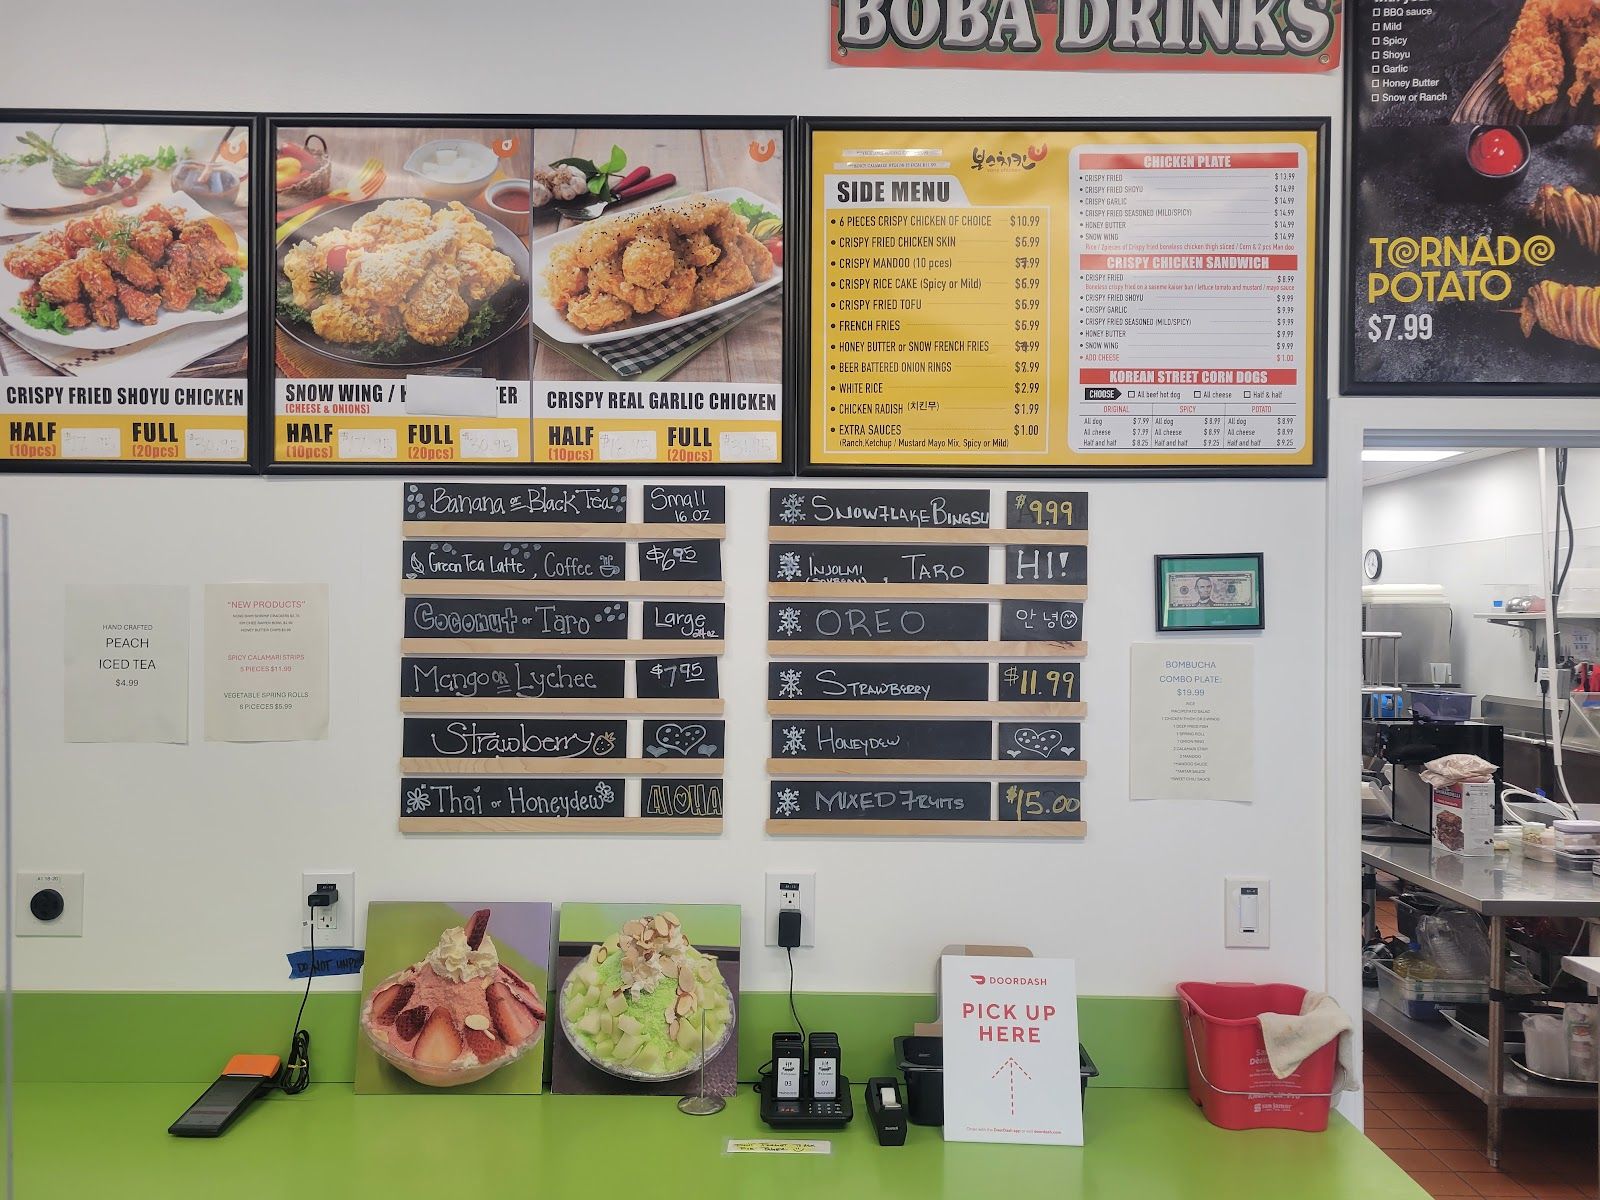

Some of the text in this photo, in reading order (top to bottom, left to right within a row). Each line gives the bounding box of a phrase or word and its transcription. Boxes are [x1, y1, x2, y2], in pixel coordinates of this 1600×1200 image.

[1384, 8, 1403, 16] BBQ
[840, 0, 1331, 52] BOBA DRINKS
[1383, 22, 1402, 31] Mild
[1383, 36, 1407, 46] Spicy
[1383, 51, 1410, 60] Shoyu
[1383, 65, 1408, 73] Garlic
[1383, 78, 1439, 89] Honey Butter
[1382, 94, 1406, 102] Snow
[1419, 93, 1447, 101] Ranch
[1144, 156, 1231, 168] CHICKEN PLATE
[838, 181, 950, 202] SIDE MENU
[840, 216, 1039, 226] 6 PIECES CRISPY CHICKEN OF CHOICE $10.99
[839, 237, 956, 248] CRISPY FRIED CHICKEN SKIN
[1369, 235, 1555, 268] TORNADO
[840, 258, 868, 269] CRISPY
[873, 258, 909, 268] MANDOO
[913, 258, 926, 268] (10
[929, 258, 951, 269] pces)
[1107, 257, 1269, 269] CRISPY CHICKEN SANDWICH
[1368, 270, 1512, 303] POTATO
[1368, 313, 1433, 342] $7.99
[1109, 371, 1267, 383] KOREAN STREET CORN DOGS
[7, 387, 244, 406] CRISPY FRIED SHOYU CHICKEN
[286, 384, 334, 403] SNOW
[339, 385, 385, 403] WING
[839, 383, 1039, 393] WHITE RICE $2.99
[1089, 390, 1115, 398] CHOOSE
[285, 403, 370, 415] (CHEESE & ONIONS)
[547, 391, 776, 411] CRISPY REAL GARLIC CHICKEN
[839, 404, 872, 414] CHICKEN
[875, 404, 903, 414] RADISH
[1015, 403, 1039, 414] $1.99
[10, 422, 56, 441] HALF
[132, 423, 178, 442] FULL
[286, 424, 333, 444] HALF
[408, 424, 453, 444] FULL
[548, 426, 594, 446] HALF
[667, 427, 712, 447] FULL
[839, 424, 1038, 435] EXTRA SAUCES $1.00
[10, 444, 56, 457] (10pcs)
[133, 445, 178, 458] (20pcs)
[286, 445, 333, 459] (10pcs)
[408, 446, 453, 460] (20pcs)
[548, 447, 594, 461] (10pcs)
[667, 448, 713, 462] (20pcs)
[431, 487, 613, 514] Banana or Black Tea
[650, 487, 705, 510] Small
[1015, 494, 1073, 526] $9.99
[429, 552, 593, 577] Green Tea Latte Coffee
[809, 554, 964, 580] INJOLMI TARO
[1017, 550, 1069, 579] HI!
[414, 602, 589, 634] Coconut or Taro
[655, 607, 706, 636] Large
[816, 609, 925, 637] OREO
[106, 638, 149, 648] PEACH
[99, 659, 156, 669] ICED TEA
[1166, 661, 1216, 669] BOMBUCHA
[116, 679, 138, 687] $4.99
[414, 665, 490, 697] Mango
[516, 663, 596, 698] Lychee
[1004, 666, 1074, 699] $11.99
[1159, 675, 1223, 684] COMBO PLATE:
[1177, 688, 1205, 697] $19.99
[431, 722, 595, 758] Strawberry
[430, 785, 604, 817] Thai or Honeydew
[647, 784, 722, 815] ALOHA
[815, 791, 895, 811] MIXED
[1006, 785, 1080, 820] $15.00
[990, 977, 1047, 985] DOORDASH
[962, 1003, 1056, 1020] PICK UP
[979, 1026, 1040, 1043] HERE
